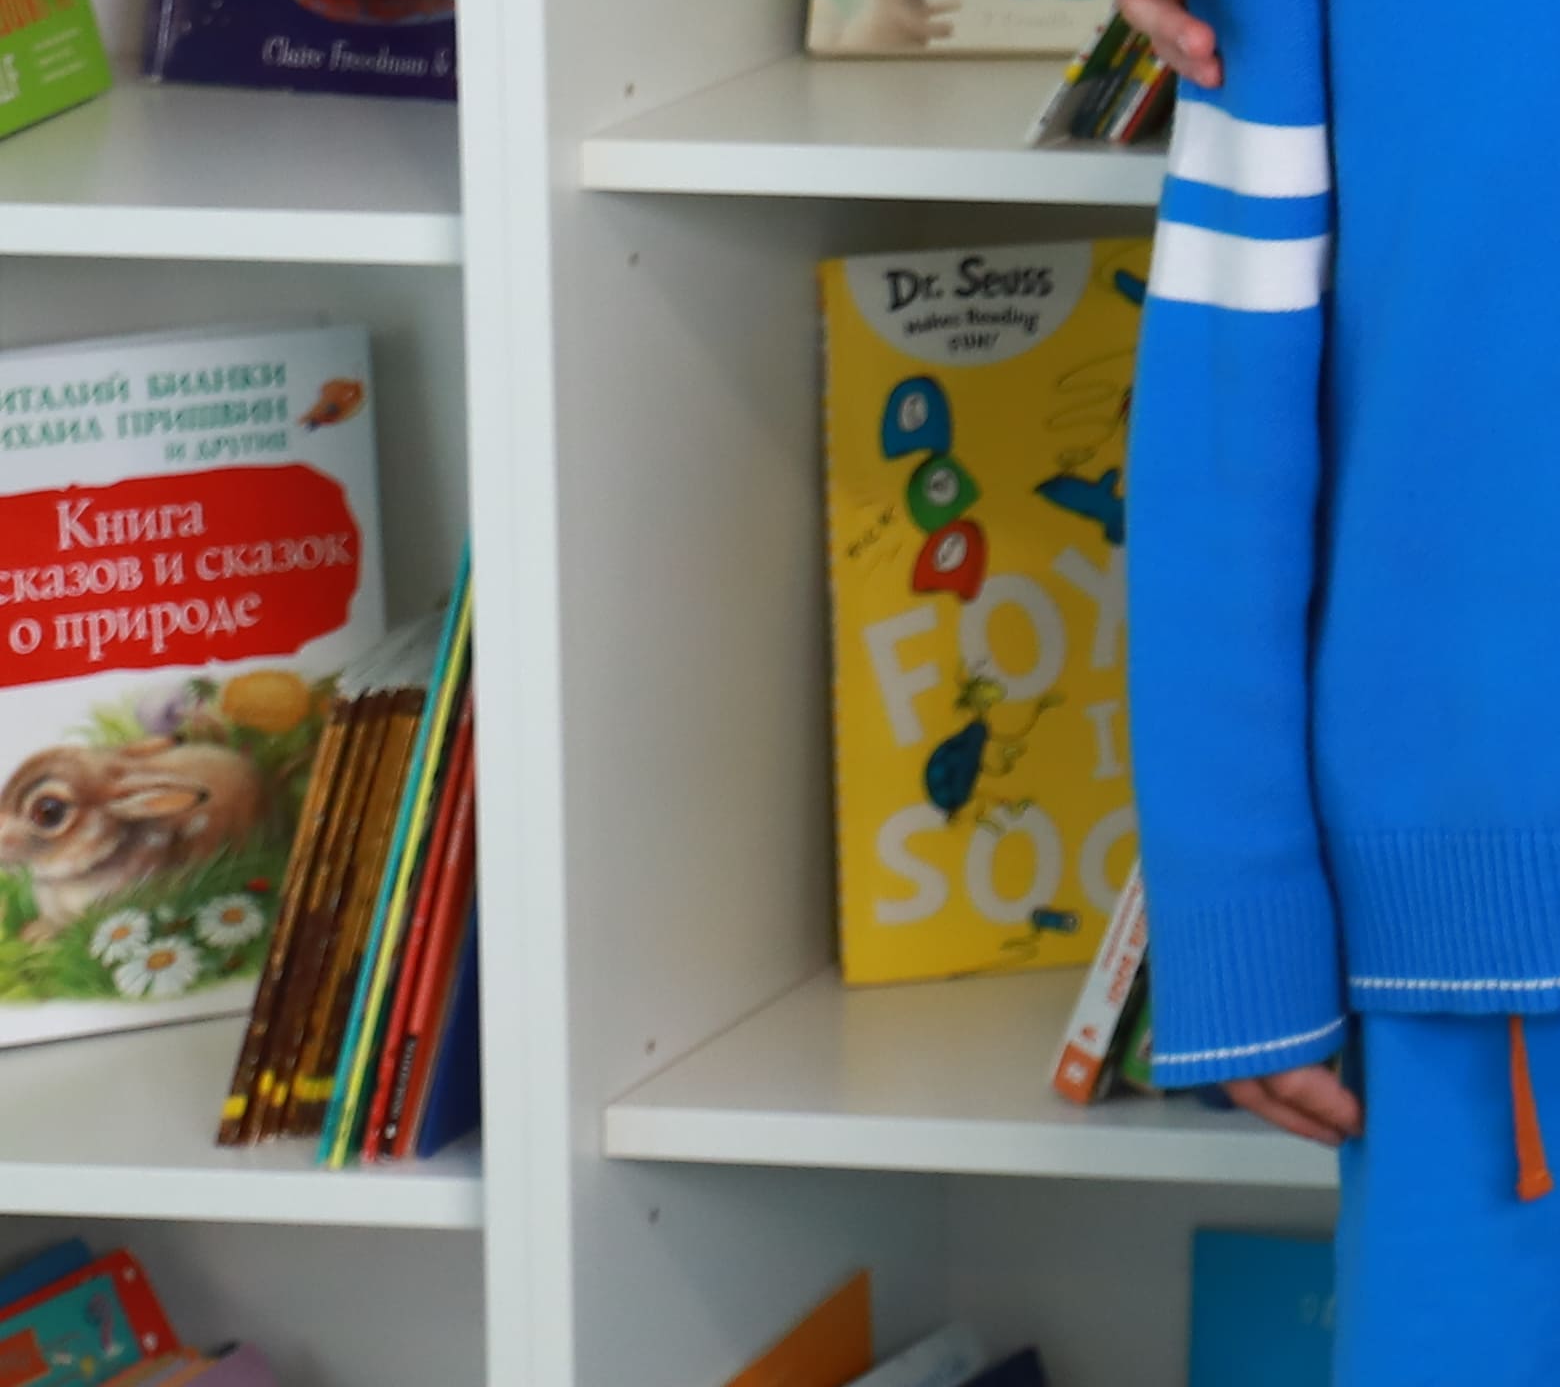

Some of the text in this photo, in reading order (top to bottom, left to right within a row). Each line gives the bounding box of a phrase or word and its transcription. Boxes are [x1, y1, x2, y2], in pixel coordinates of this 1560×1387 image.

[885, 254, 1054, 312] Dr. Seuss
[56, 498, 206, 552] Книга
[153, 553, 184, 585] и
[195, 533, 352, 582] сказок
[8, 591, 262, 662] о природе
